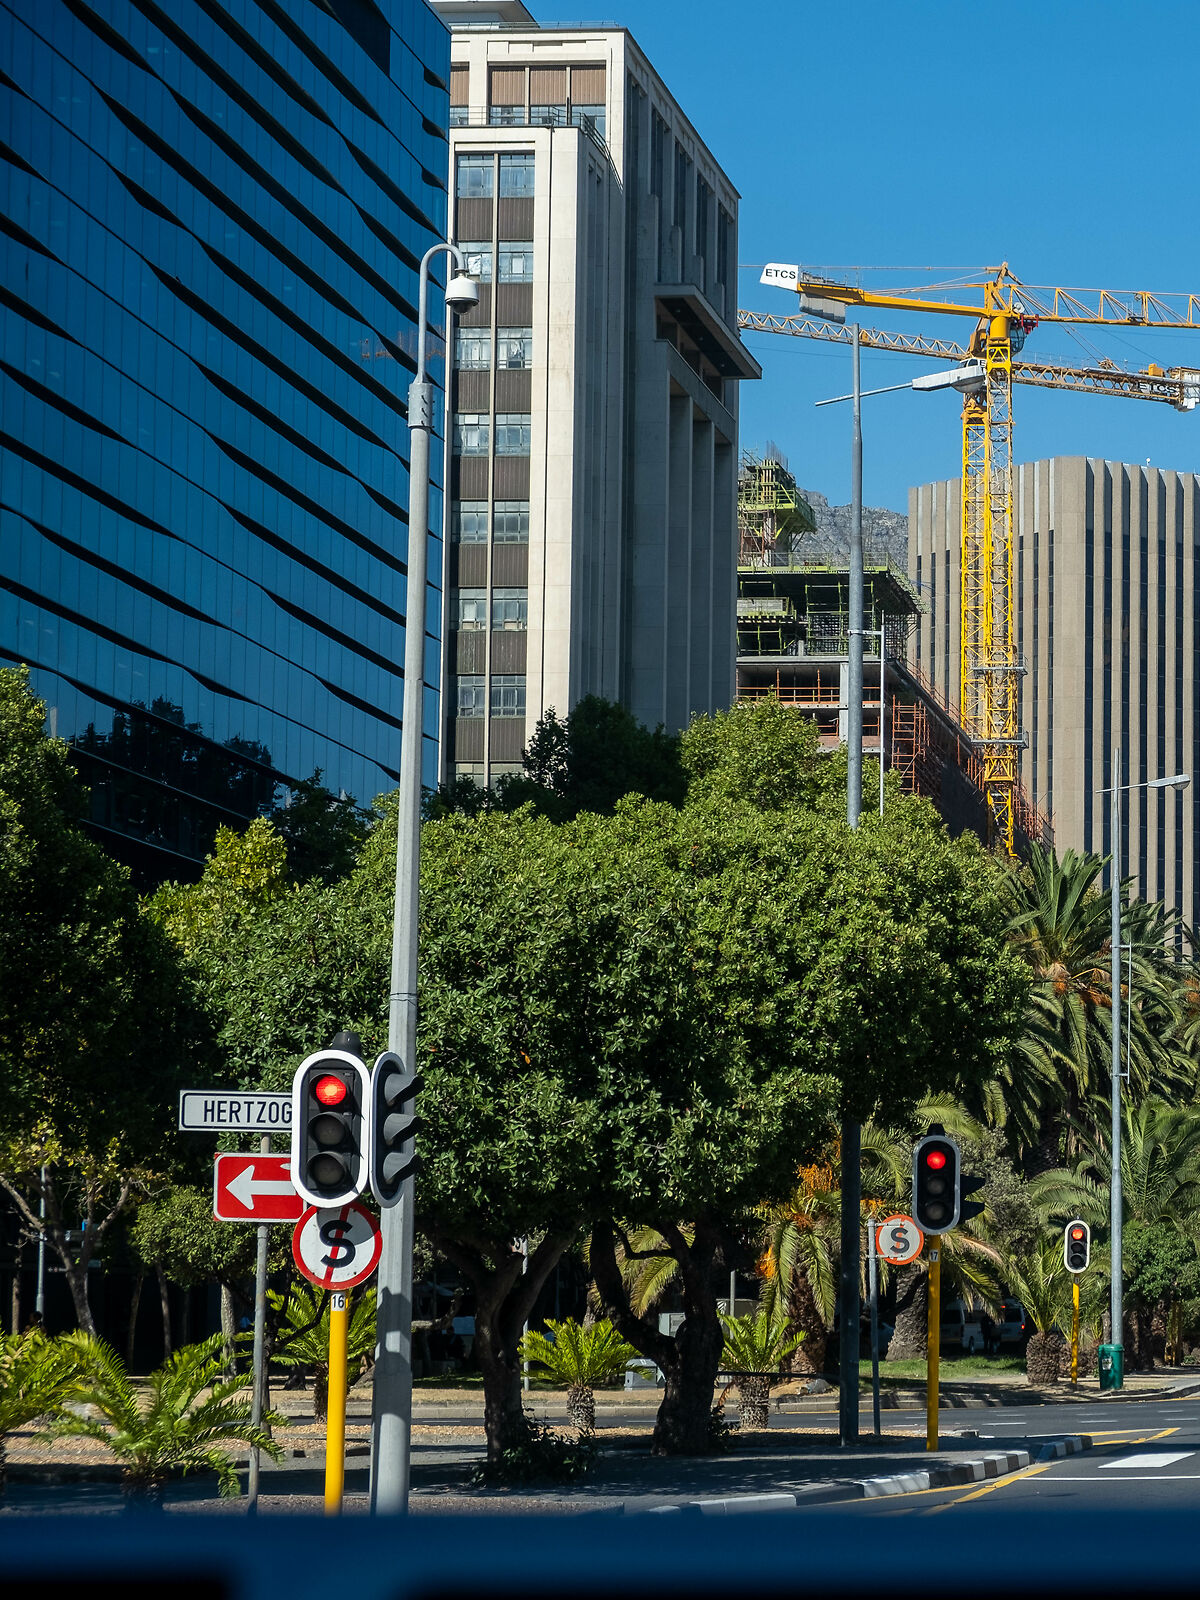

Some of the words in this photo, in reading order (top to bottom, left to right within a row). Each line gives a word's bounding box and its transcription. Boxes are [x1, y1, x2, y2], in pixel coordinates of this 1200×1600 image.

[765, 268, 797, 280] ETCS
[203, 1100, 292, 1124] HERTZOG
[319, 1219, 356, 1268] S
[889, 1227, 911, 1254] S
[930, 1251, 939, 1261] 17
[332, 1294, 345, 1309] 16
